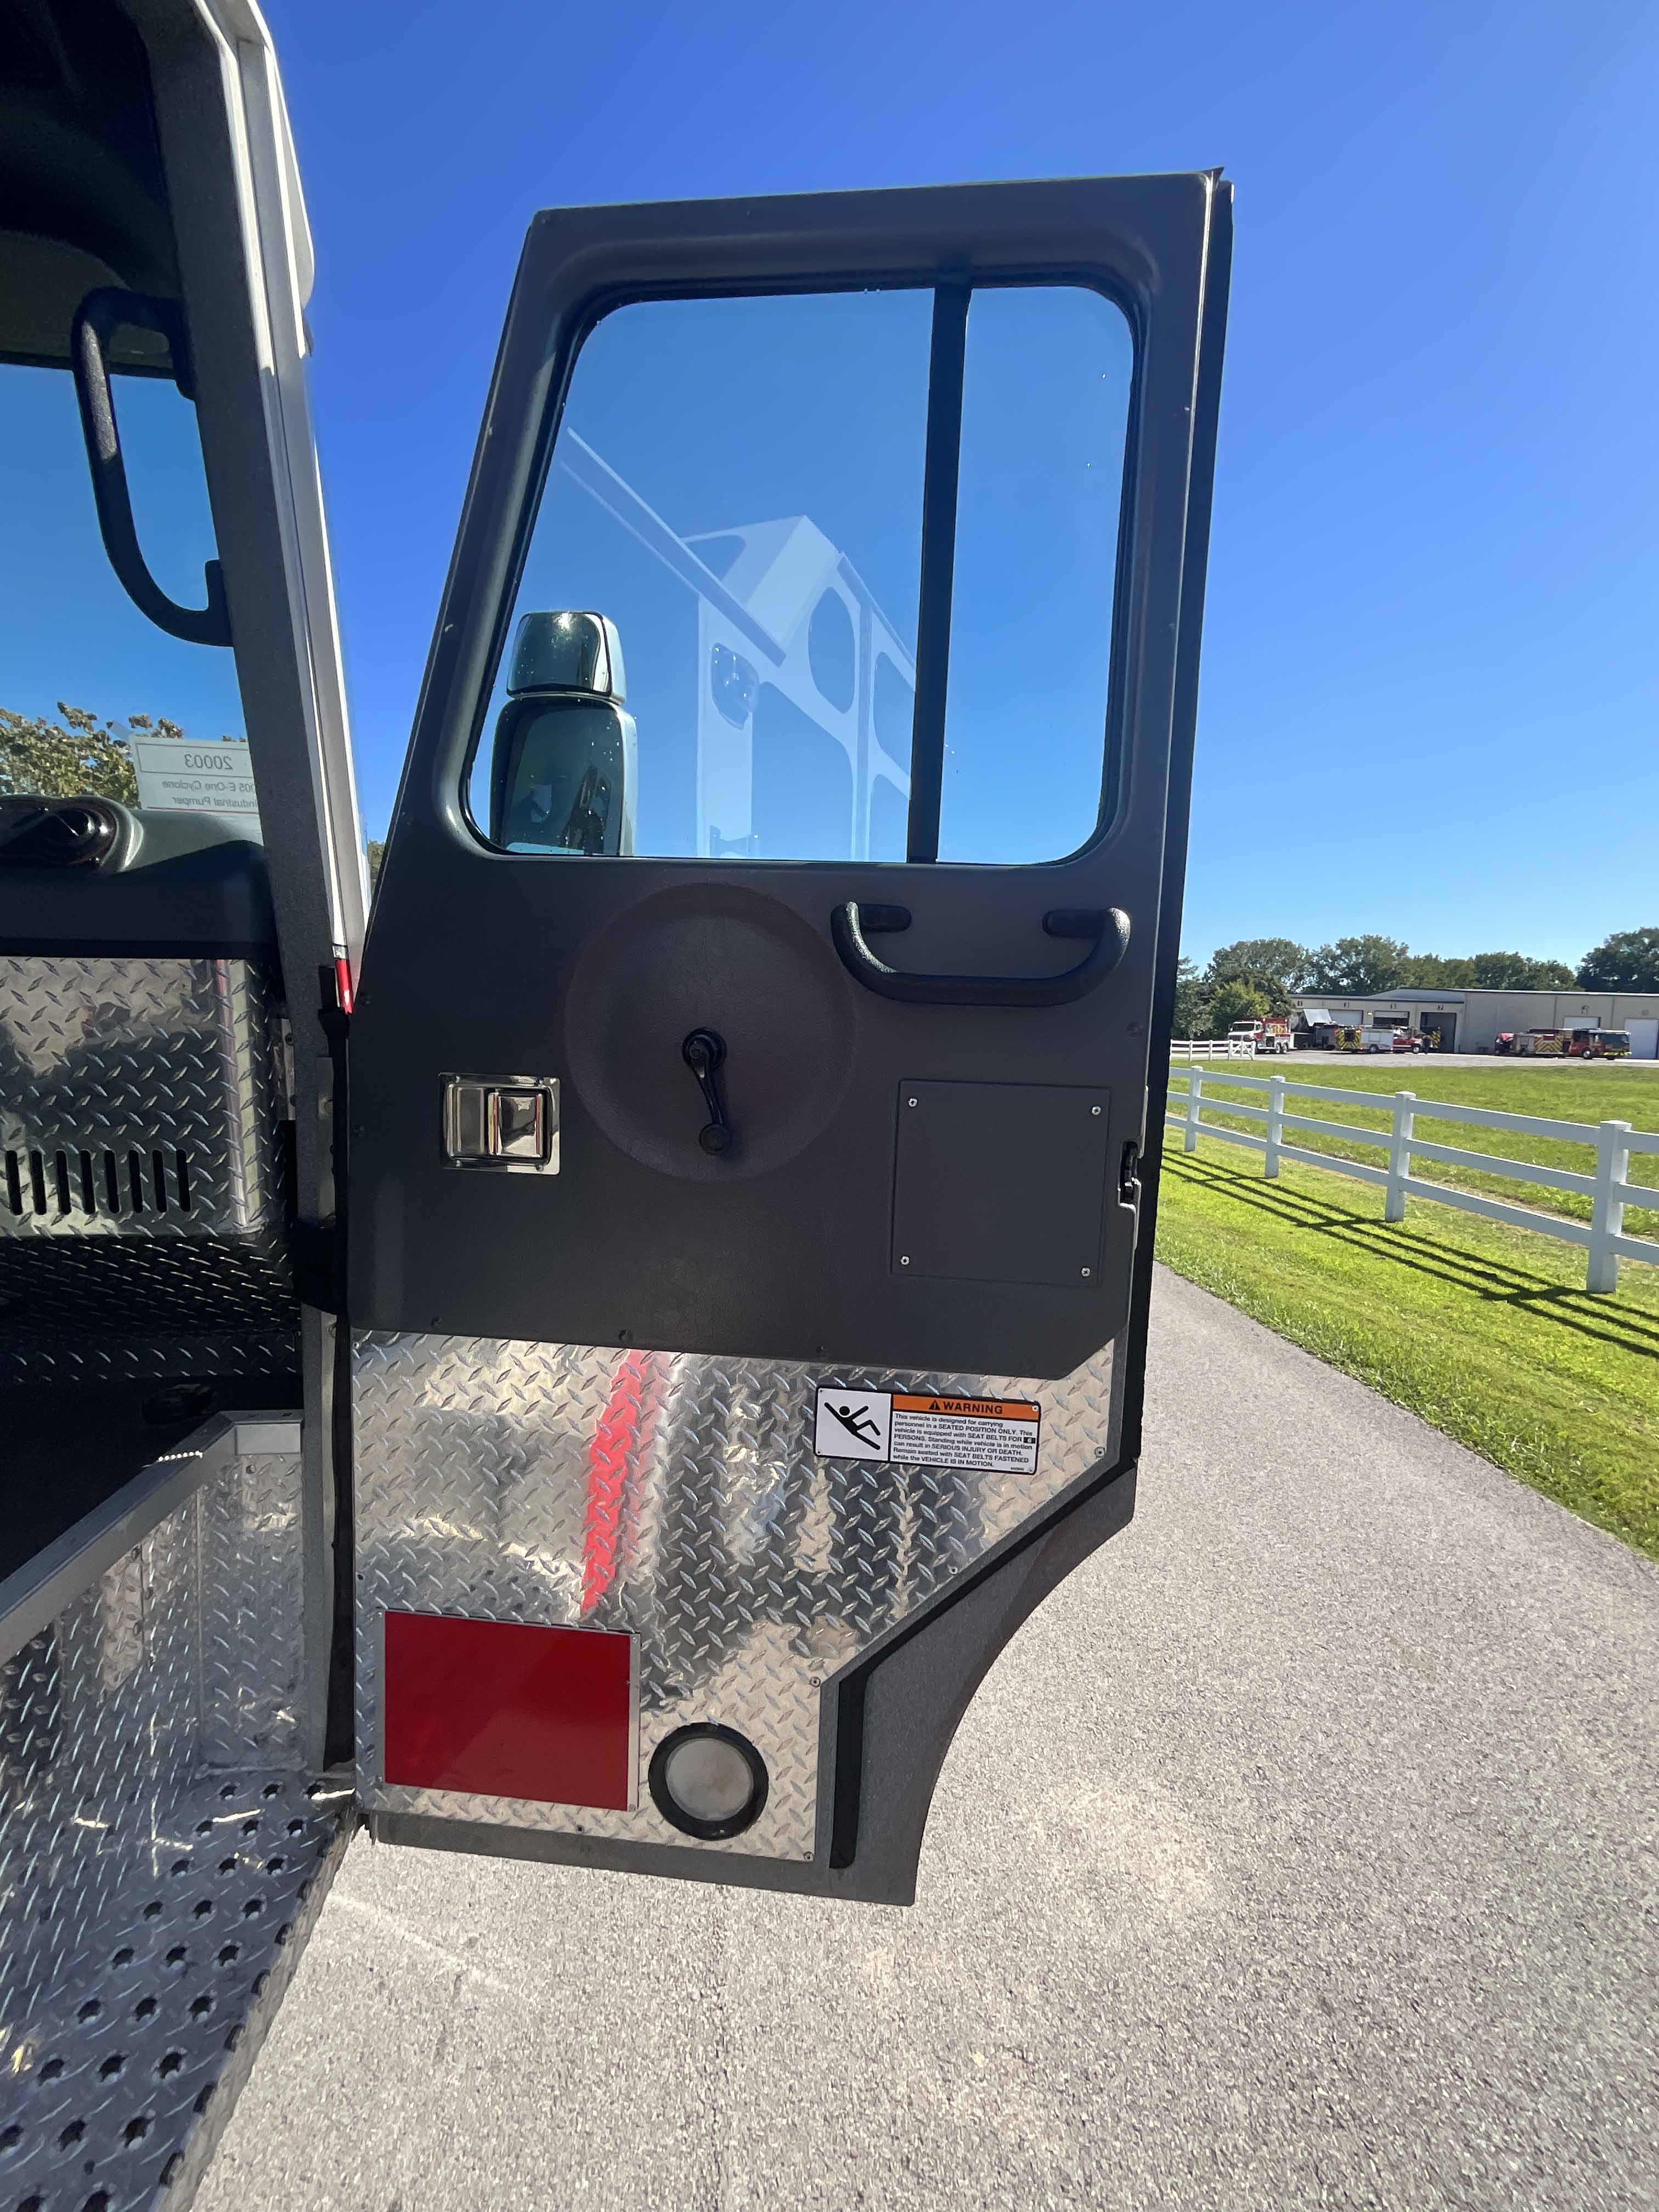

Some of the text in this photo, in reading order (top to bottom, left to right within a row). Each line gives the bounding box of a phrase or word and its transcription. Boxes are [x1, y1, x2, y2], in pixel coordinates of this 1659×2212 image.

[942, 1402, 1003, 1414] WARNING
[966, 1459, 994, 1468] MOTION.
[994, 1455, 1029, 1463] FASTENED
